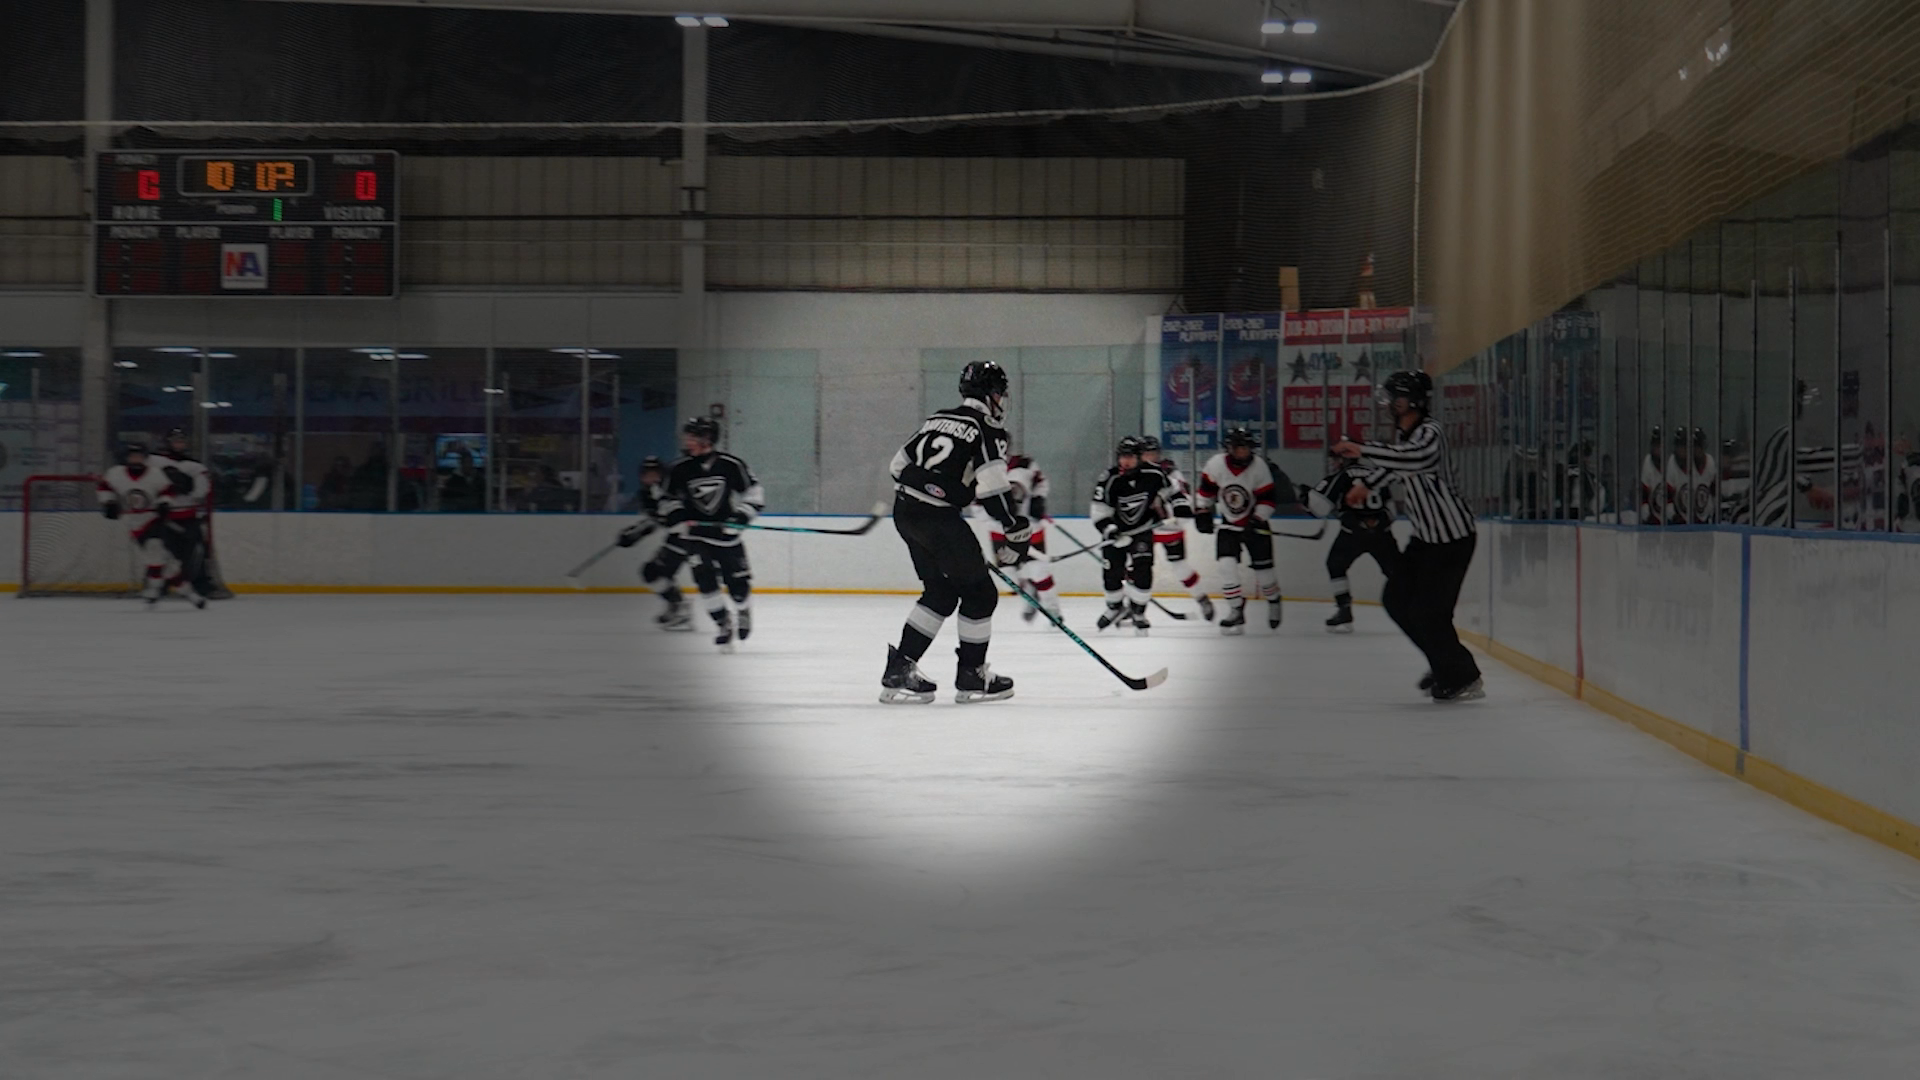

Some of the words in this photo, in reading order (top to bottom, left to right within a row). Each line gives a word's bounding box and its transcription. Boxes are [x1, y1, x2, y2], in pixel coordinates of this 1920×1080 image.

[111, 205, 161, 220] HOME
[323, 205, 386, 220] VISITOR
[915, 433, 955, 470] 12
